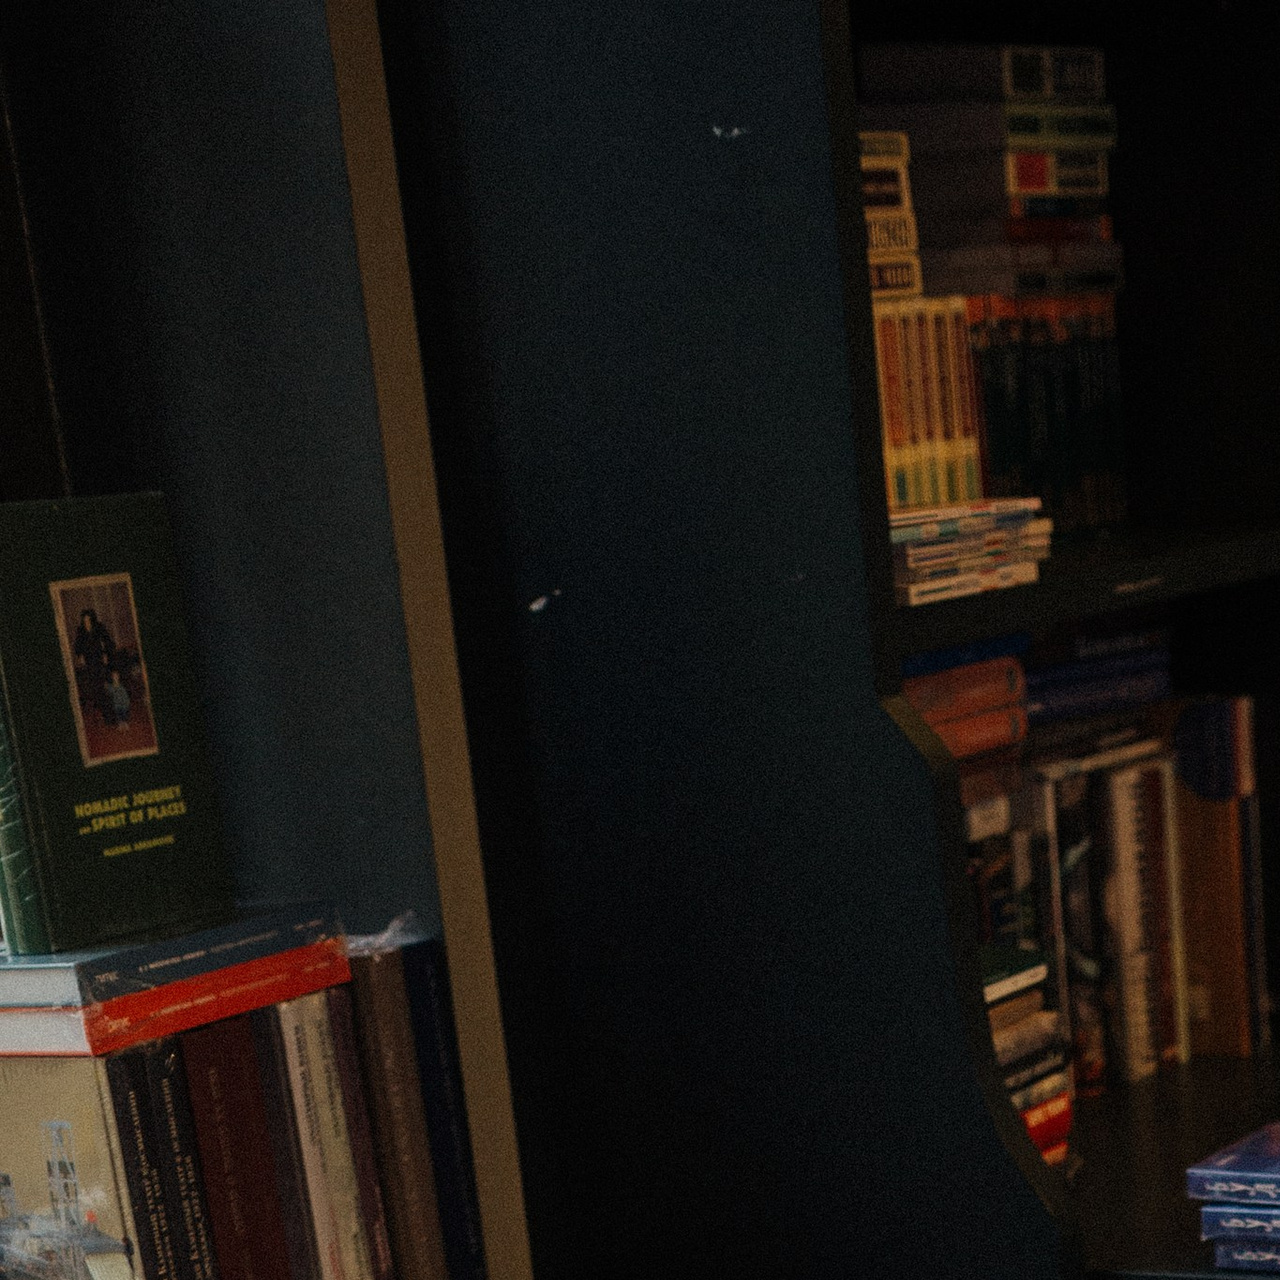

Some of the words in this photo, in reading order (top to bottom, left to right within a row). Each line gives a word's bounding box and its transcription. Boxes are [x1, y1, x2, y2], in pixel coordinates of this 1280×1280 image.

[74, 795, 129, 818] NOMADIC
[132, 784, 181, 807] JOURNEY
[91, 812, 126, 833] SPIRIT
[129, 809, 143, 824] OF
[146, 800, 186, 820] PLACES
